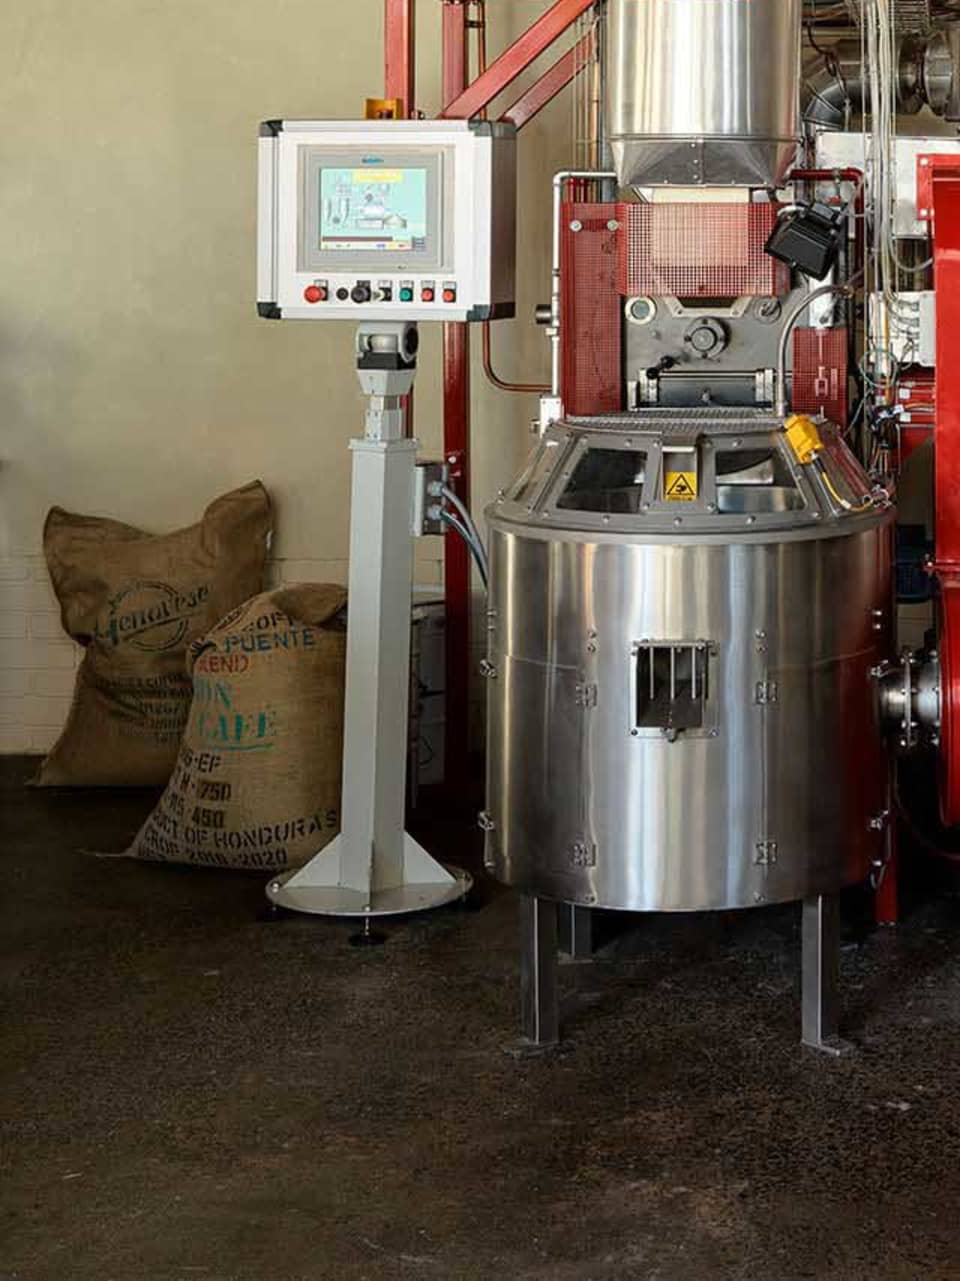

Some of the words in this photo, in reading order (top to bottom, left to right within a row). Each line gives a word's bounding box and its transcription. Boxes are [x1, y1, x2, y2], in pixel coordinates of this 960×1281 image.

[223, 628, 315, 653] PUENTE
[184, 830, 209, 846] OF
[213, 809, 337, 849] HONDURAS
[191, 806, 225, 828] 450
